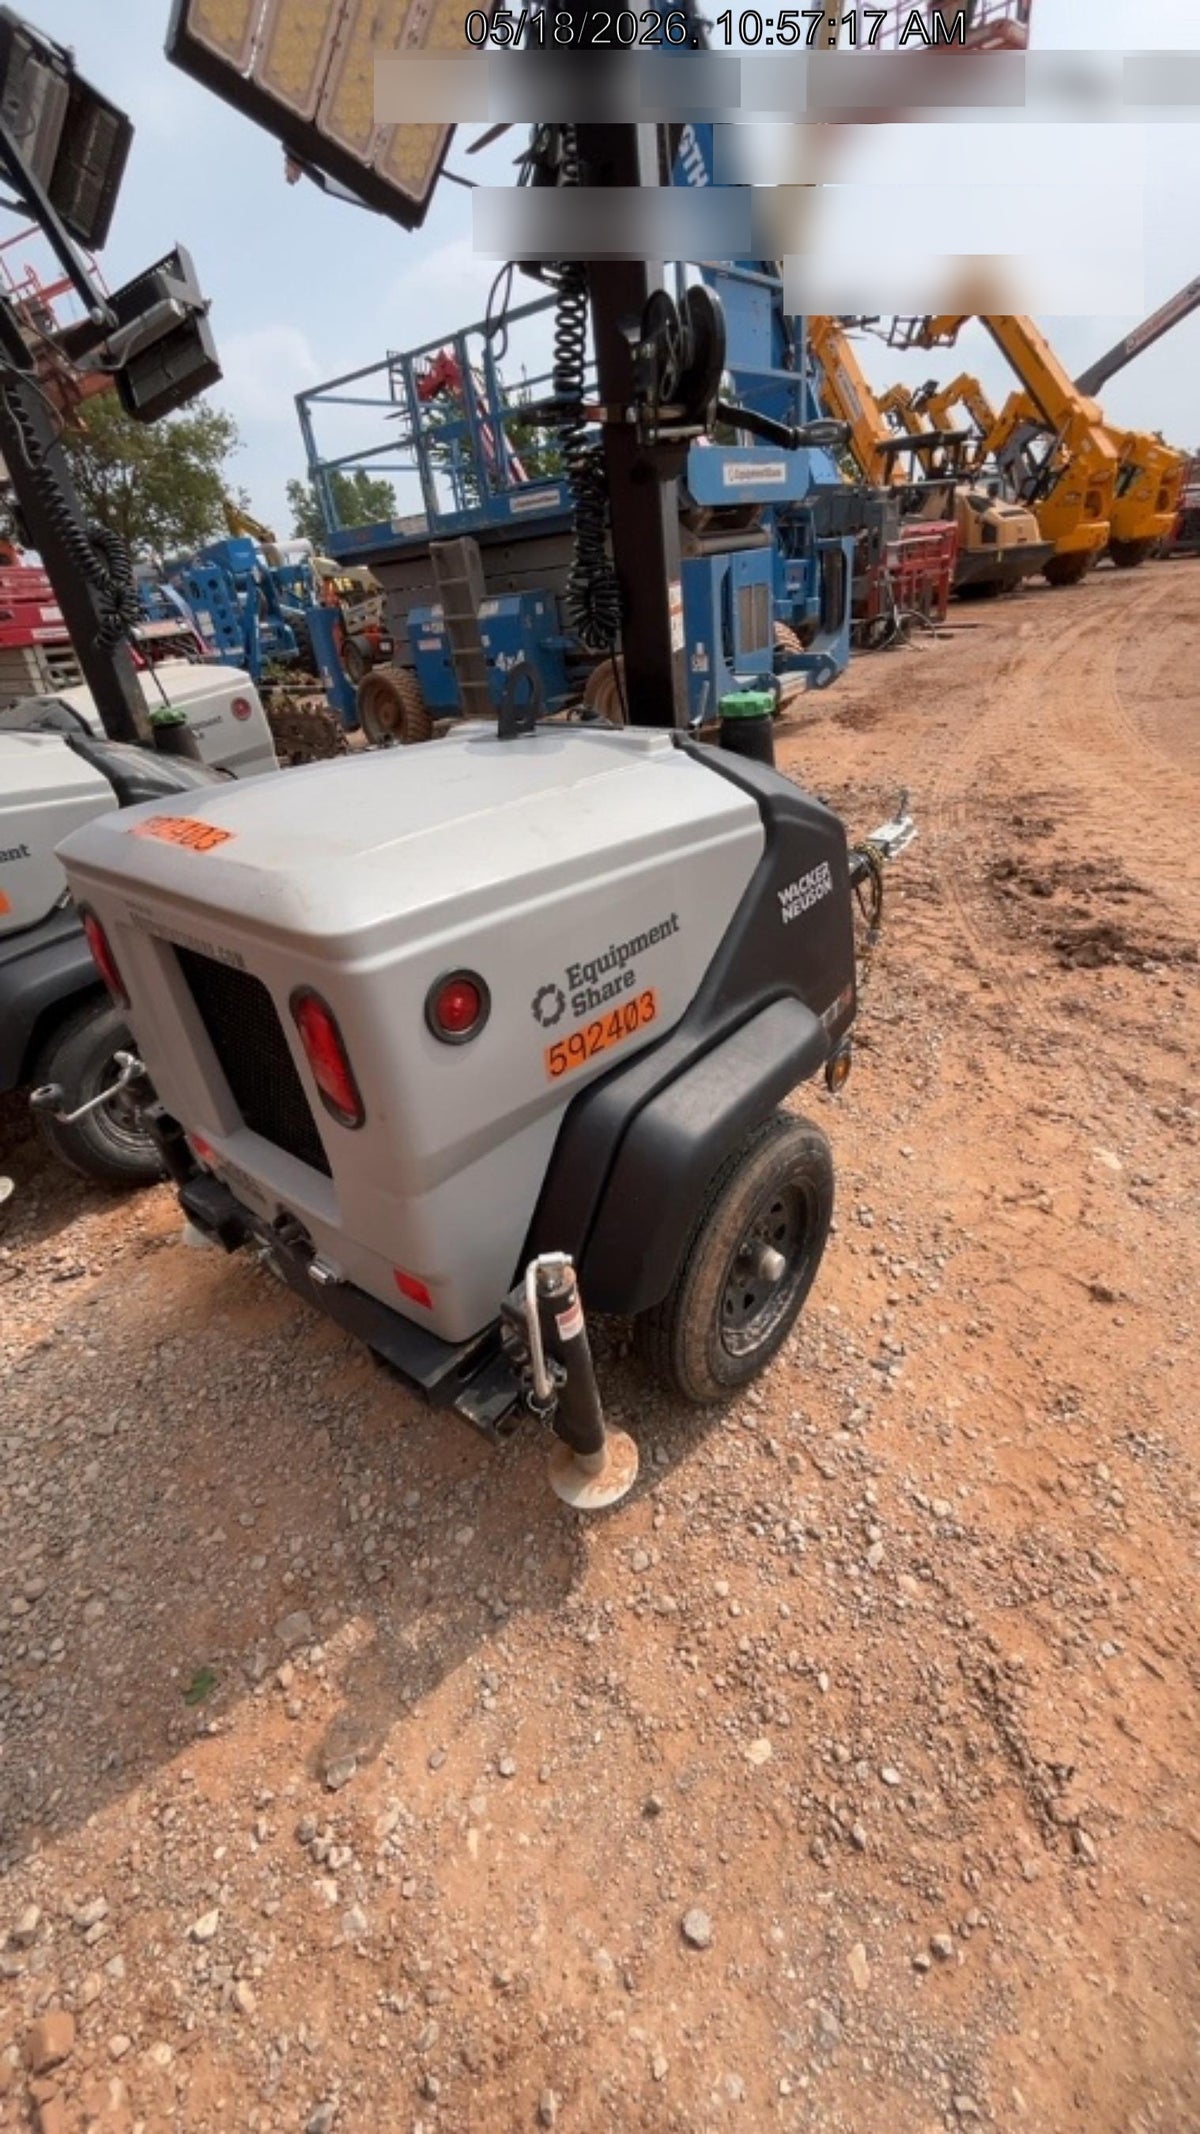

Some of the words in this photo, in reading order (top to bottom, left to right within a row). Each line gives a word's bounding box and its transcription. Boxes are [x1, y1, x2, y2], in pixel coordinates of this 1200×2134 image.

[777, 861, 831, 906] WACKER
[782, 879, 833, 925] NEUSON
[565, 912, 681, 991] Equipment
[571, 969, 637, 1018] Share
[549, 990, 656, 1077] 592403
